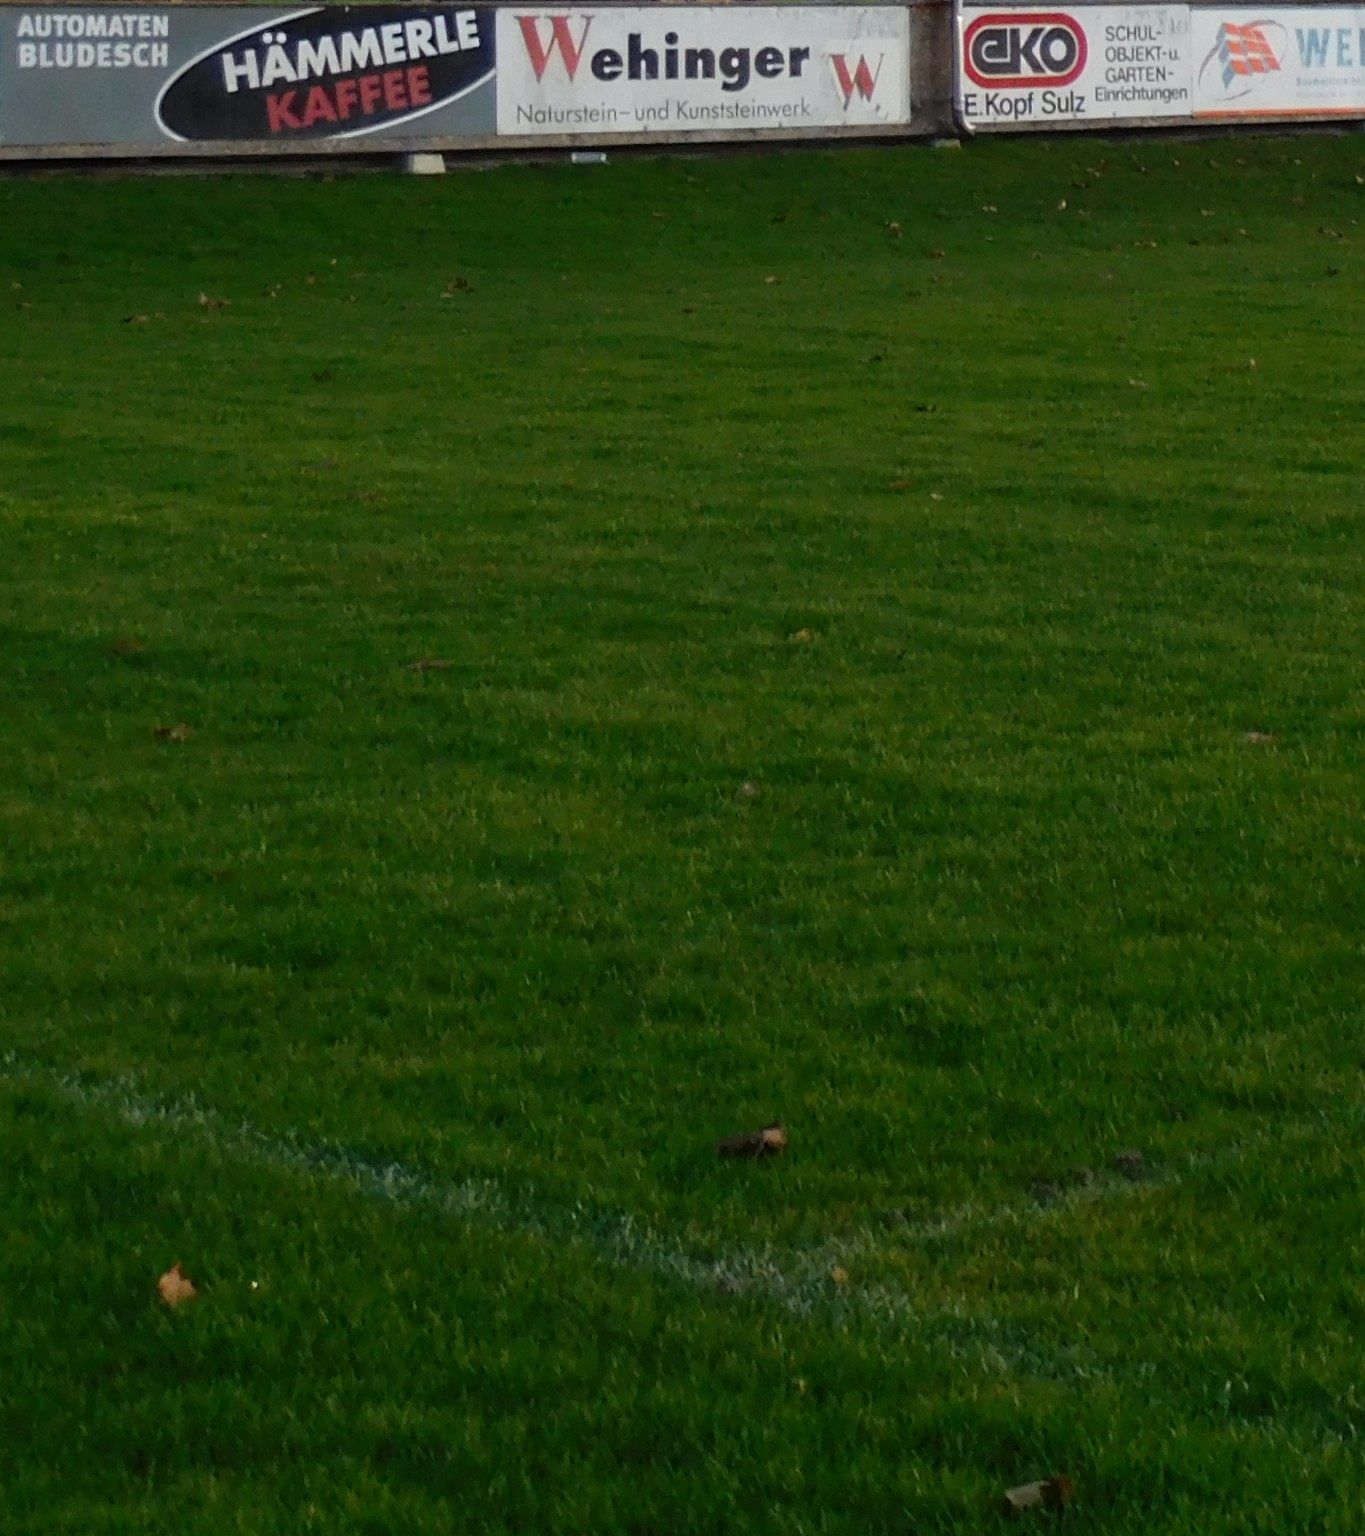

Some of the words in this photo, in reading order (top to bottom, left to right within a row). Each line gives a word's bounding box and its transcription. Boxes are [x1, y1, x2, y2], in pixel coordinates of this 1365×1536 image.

[17, 15, 169, 38] AUTOMATEN
[1105, 25, 1162, 41] SCHUL-
[19, 43, 168, 68] BLUDESCH
[222, 10, 480, 92] HÄMMERLE
[515, 15, 810, 92] Wehinger
[265, 66, 433, 132] KAFFEE
[1042, 91, 1085, 114] Sulz
[1095, 86, 1187, 103] Einrichtungen
[635, 101, 669, 121] und
[677, 98, 810, 120] Kunststeinwerk
